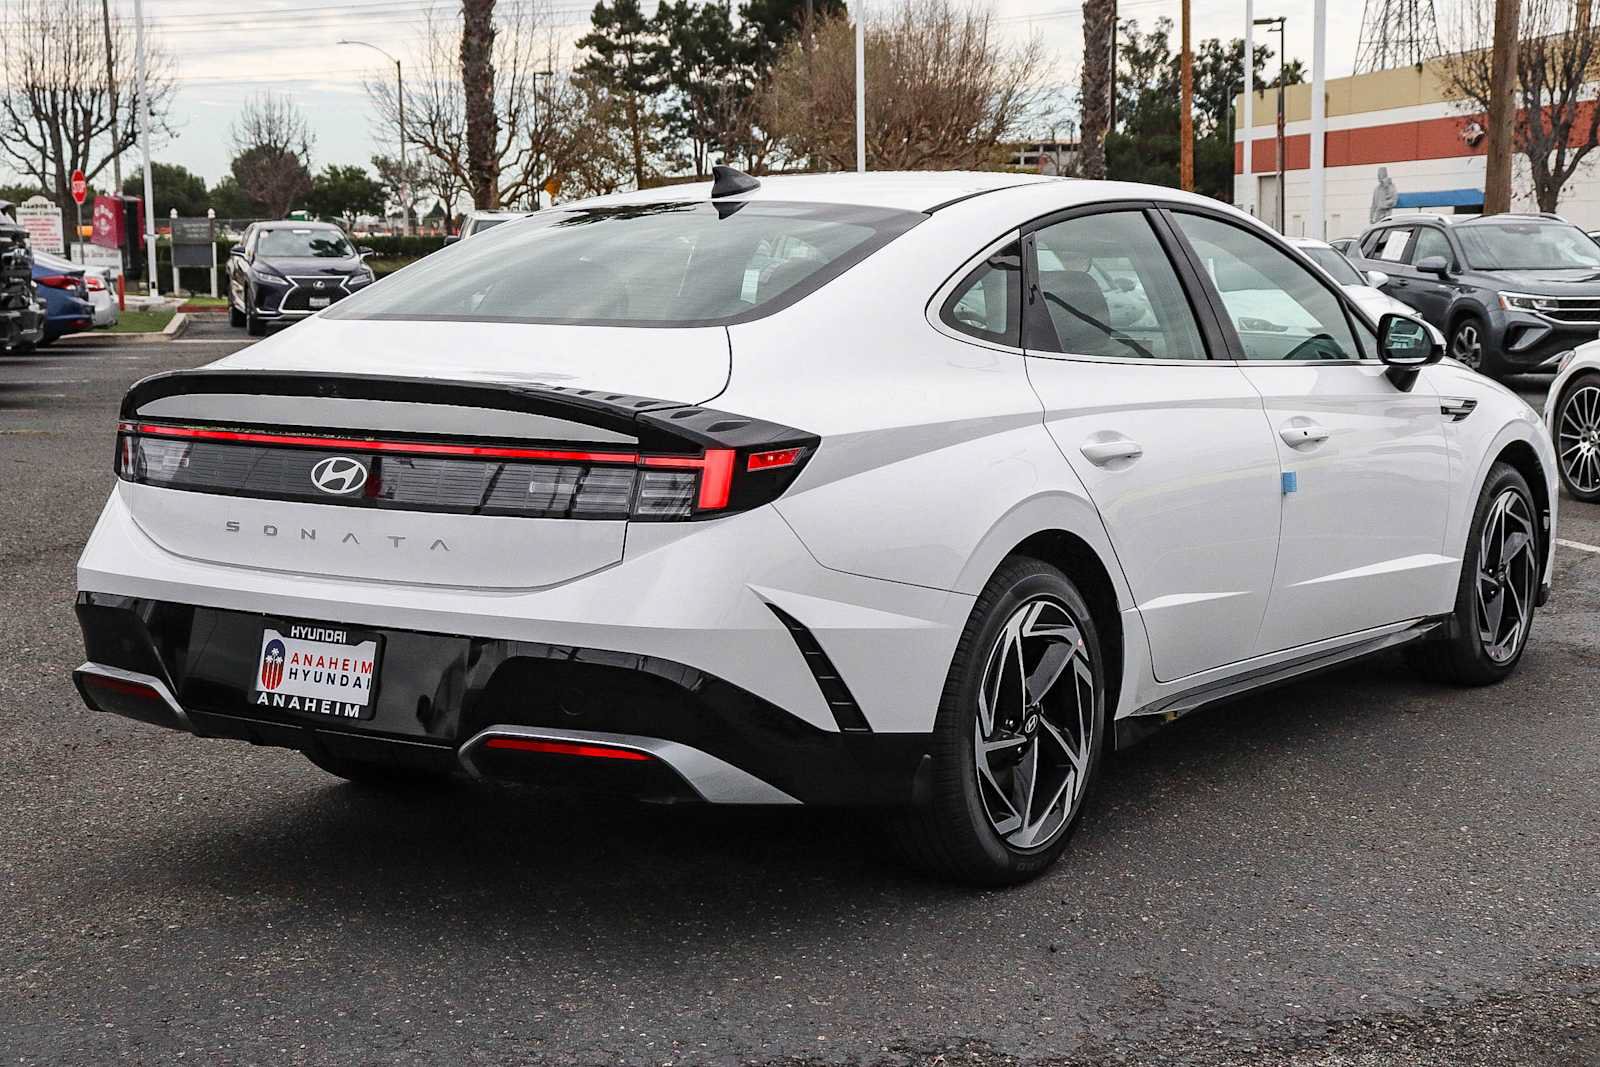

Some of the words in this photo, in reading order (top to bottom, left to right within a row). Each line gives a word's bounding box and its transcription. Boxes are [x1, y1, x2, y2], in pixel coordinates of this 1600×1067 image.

[73, 180, 86, 193] STOP
[225, 520, 450, 551] SONATA
[290, 625, 347, 644] HYUNDAI
[290, 652, 374, 675] ANAHEIM
[288, 667, 371, 690] HYUNDAI
[256, 691, 360, 719] ANAHEIM
